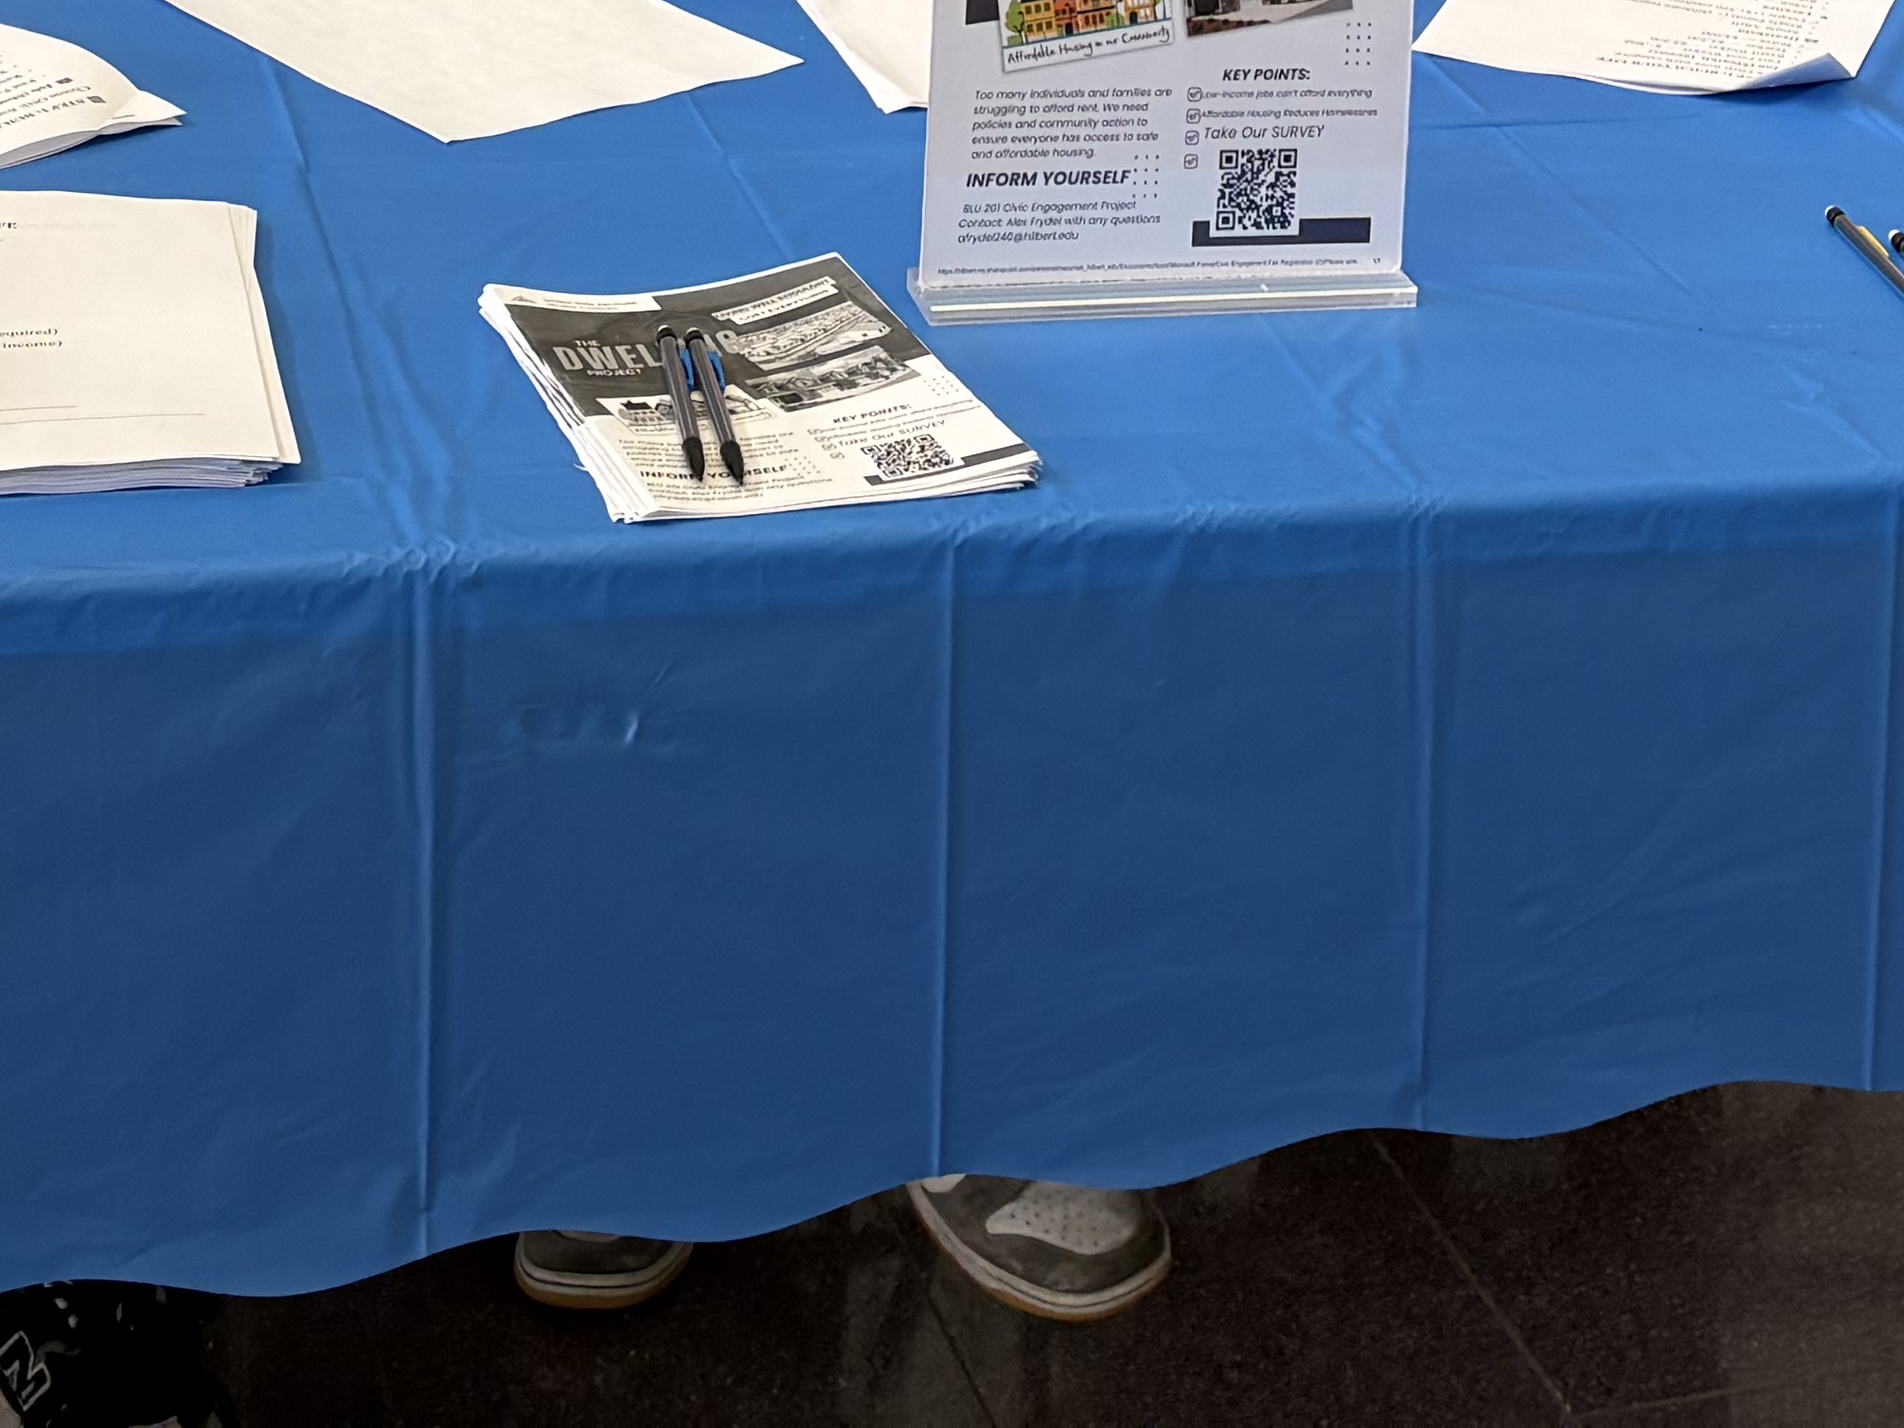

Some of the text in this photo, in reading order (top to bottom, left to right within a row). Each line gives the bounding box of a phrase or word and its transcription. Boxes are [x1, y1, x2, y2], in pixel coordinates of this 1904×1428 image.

[1222, 67, 1312, 82] KEY POINTS:
[1203, 124, 1326, 141] Take Our SURVEY
[965, 169, 1133, 189] INFORM YOURSELF
[574, 339, 601, 348] THE
[587, 368, 643, 377] PROJECT
[832, 412, 858, 424] KEY
[898, 419, 946, 436] SURVEY
